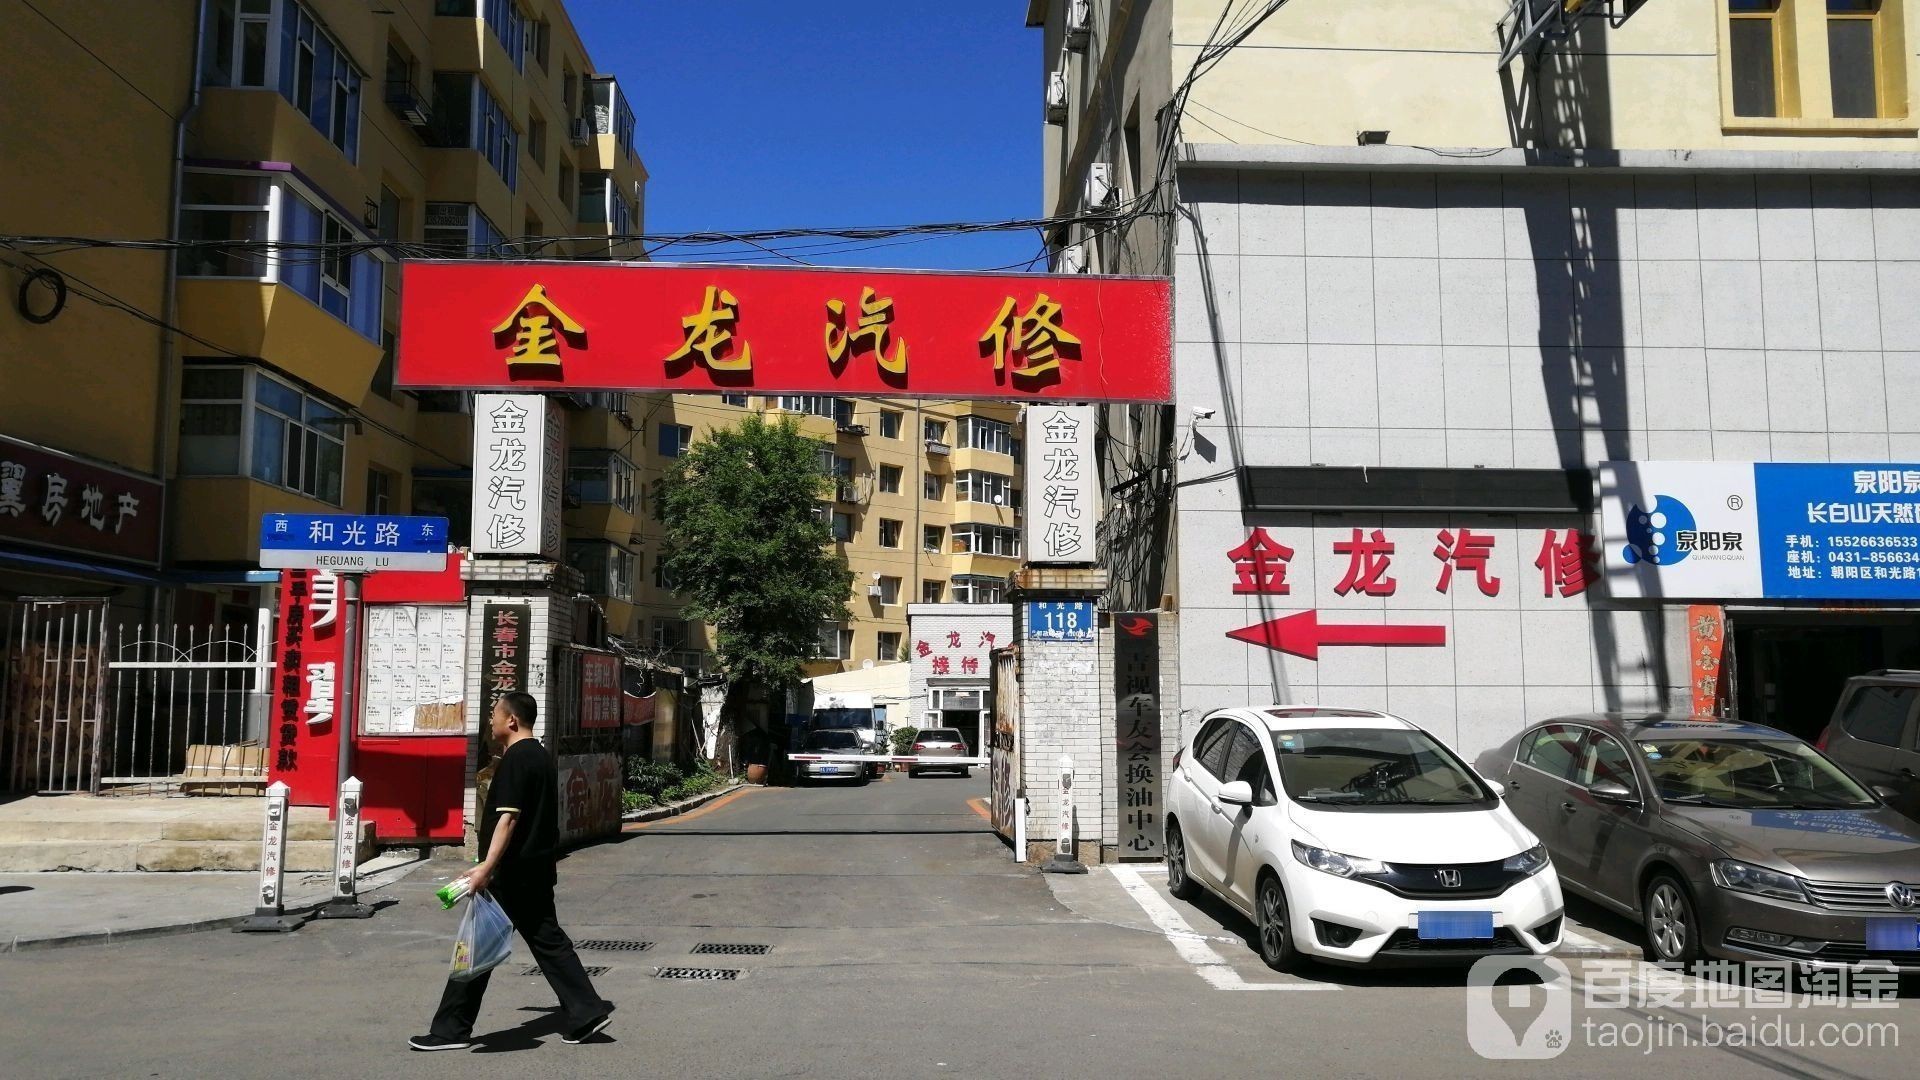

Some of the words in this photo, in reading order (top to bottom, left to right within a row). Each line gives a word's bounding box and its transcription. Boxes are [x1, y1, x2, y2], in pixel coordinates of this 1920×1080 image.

[492, 284, 1082, 377] 金龙汽修
[487, 400, 528, 549] 金龙汽修
[1043, 411, 1081, 557] 金龙汽修
[275, 519, 288, 533] 西
[309, 519, 400, 547] 和光路
[421, 523, 435, 537] 东
[1677, 531, 1743, 551] 泉阳泉
[1827, 536, 1918, 548] 15526636533
[316, 556, 364, 567] HEGUANG
[375, 557, 389, 567] LU
[1226, 526, 1601, 599] 金龙汽修
[1038, 602, 1083, 611] 和光路
[1044, 611, 1078, 629] 118
[584, 660, 618, 689] 车辆出入
[265, 821, 279, 877] 金龙汽修
[340, 816, 355, 869] 金龙汽修
